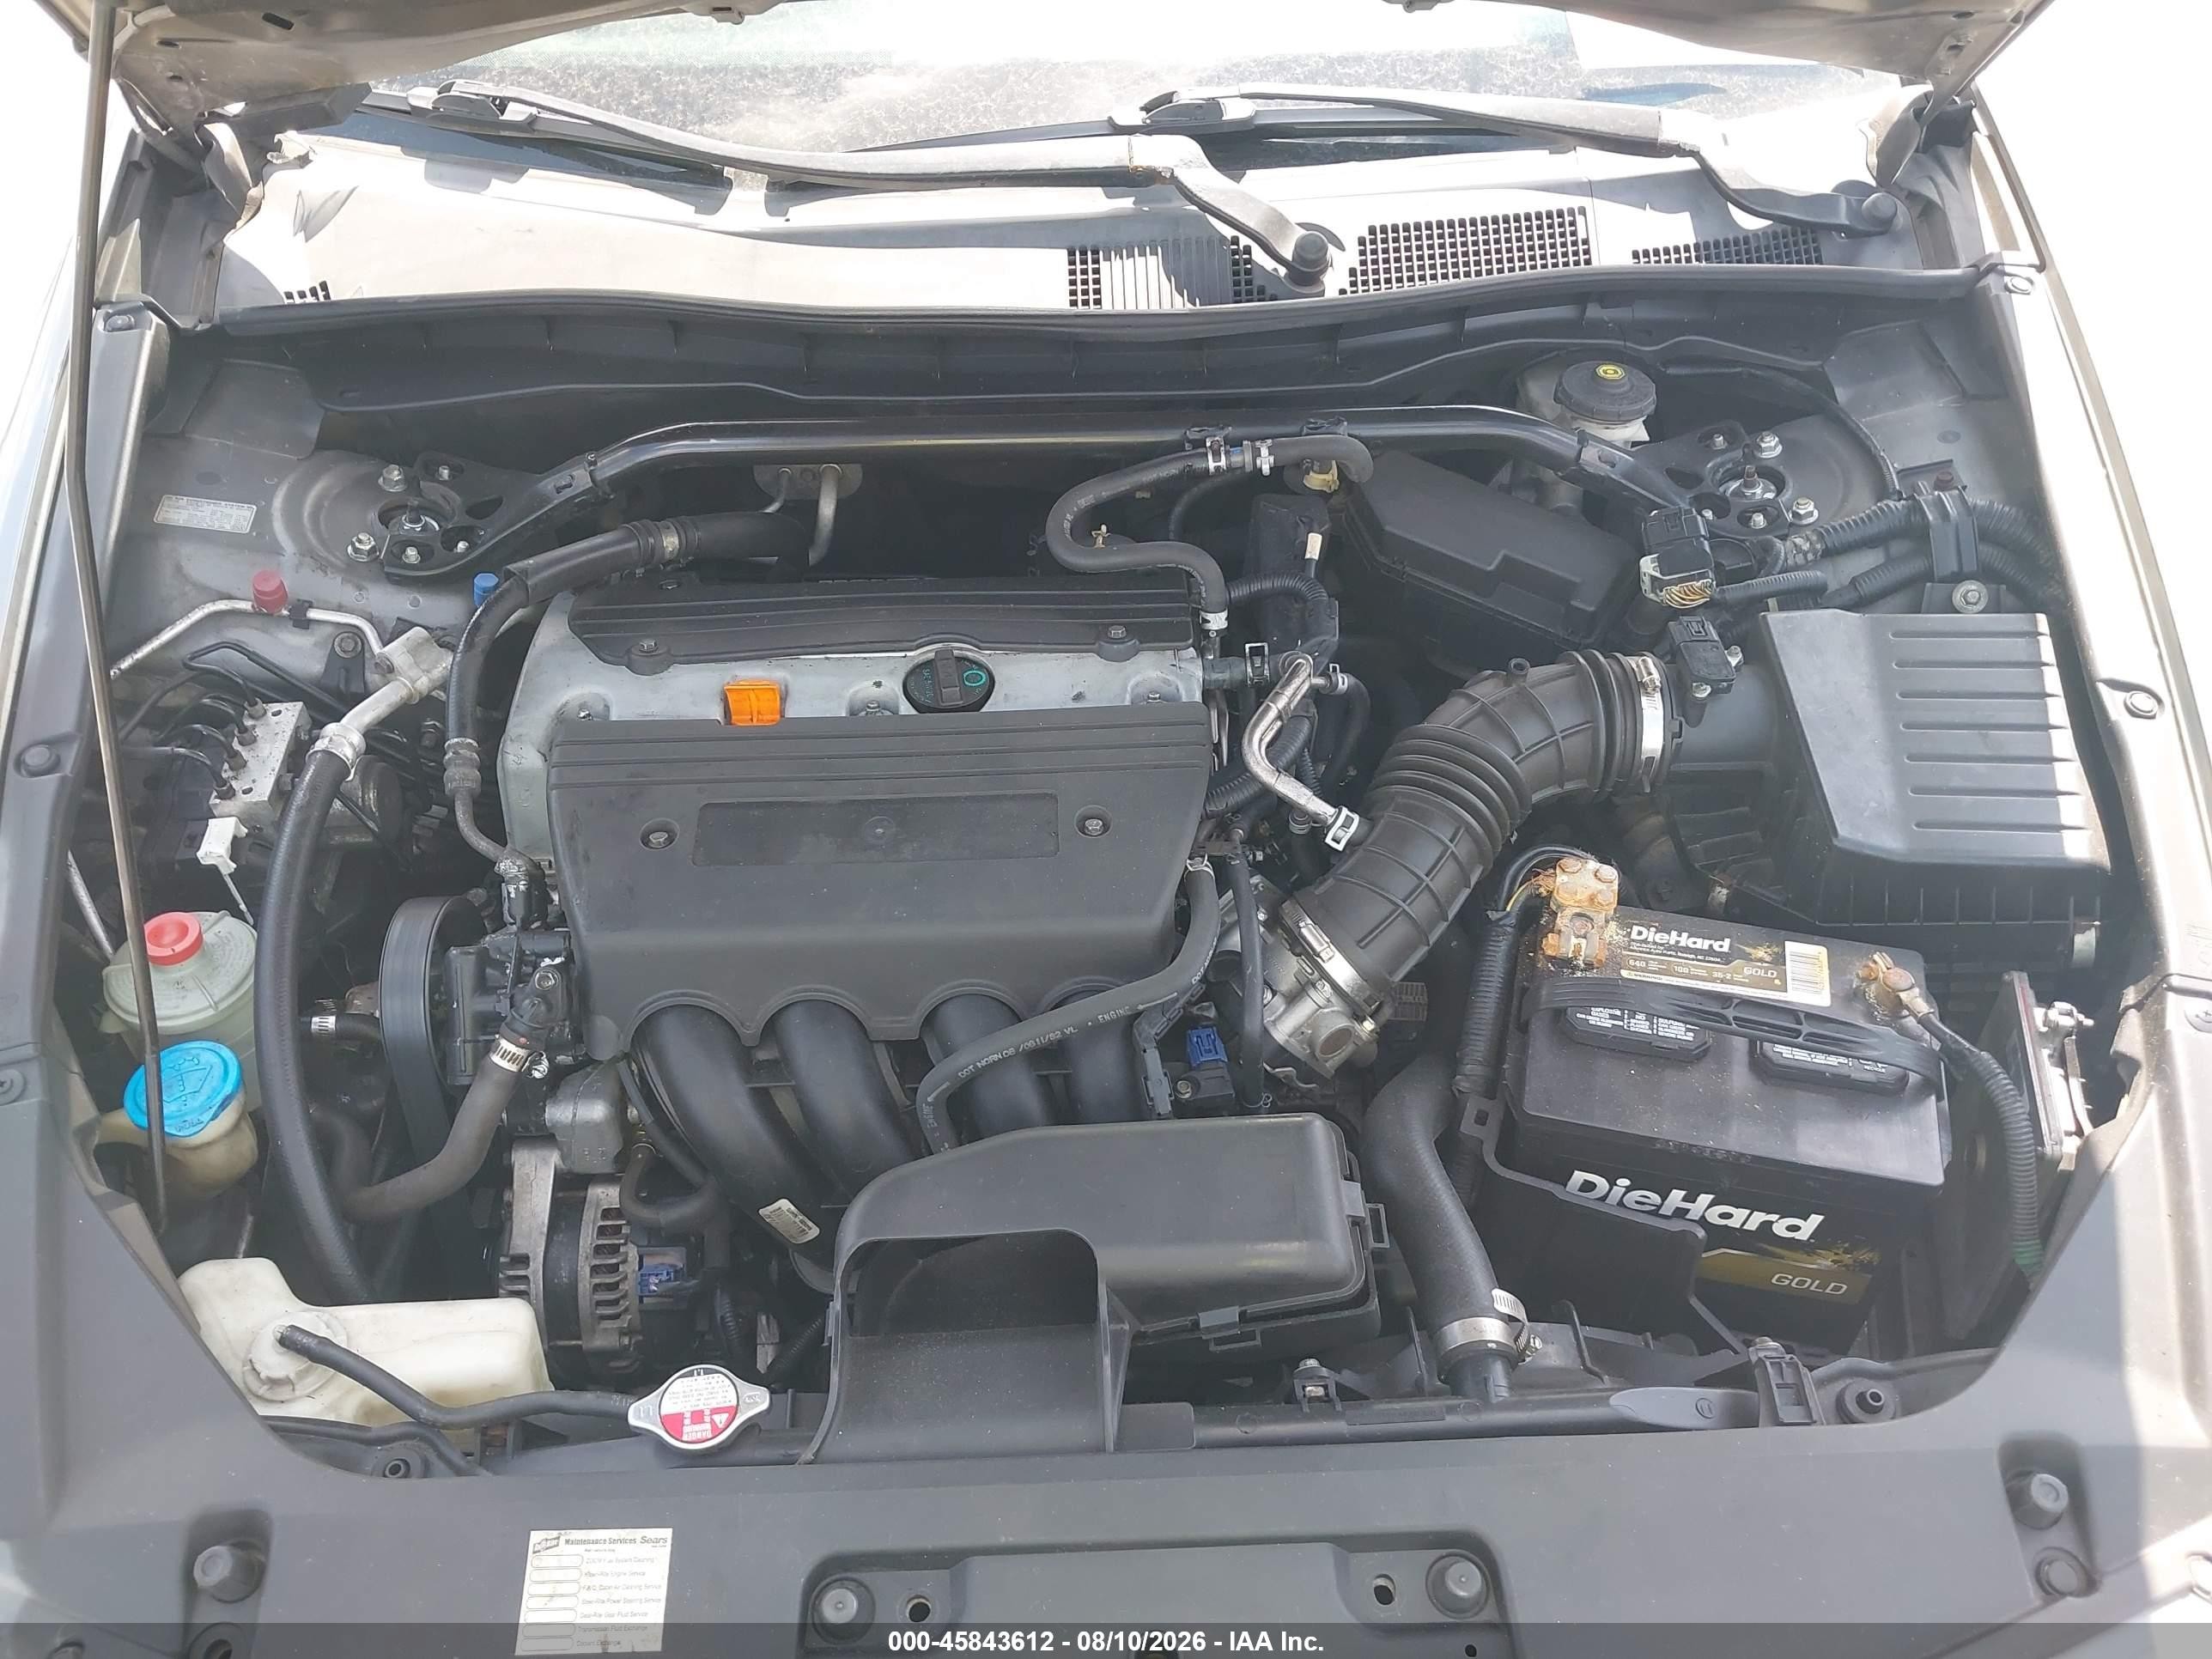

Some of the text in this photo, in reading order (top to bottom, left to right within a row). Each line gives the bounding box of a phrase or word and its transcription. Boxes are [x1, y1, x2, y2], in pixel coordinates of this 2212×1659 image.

[1631, 925, 1730, 952] DieHard
[1674, 965, 1689, 974] 100
[1744, 967, 1778, 978] GOLD
[958, 1066, 976, 1079] DOT
[1097, 1006, 1131, 1024] ENGINE
[1565, 1170, 1825, 1242] DieHard
[1771, 1273, 1847, 1296] GOLD
[608, 1536, 637, 1545] Services
[640, 1535, 667, 1545] Sears
